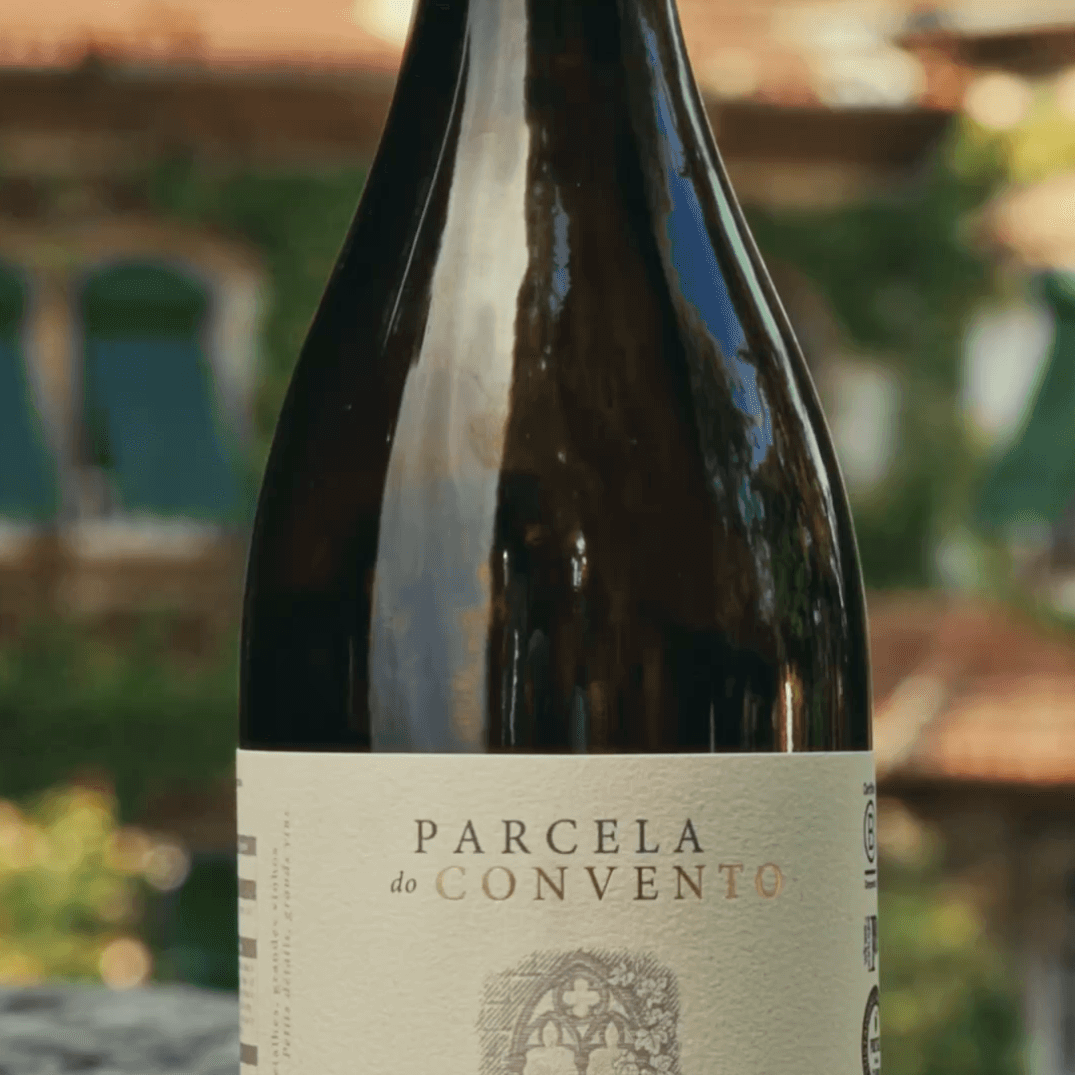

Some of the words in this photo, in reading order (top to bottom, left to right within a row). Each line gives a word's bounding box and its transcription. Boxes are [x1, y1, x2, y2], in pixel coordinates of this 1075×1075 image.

[414, 817, 706, 855] PARCELA
[269, 847, 279, 911] vinhos
[390, 870, 418, 894] do
[435, 861, 785, 902] CONVENTO
[270, 919, 281, 995] grandes
